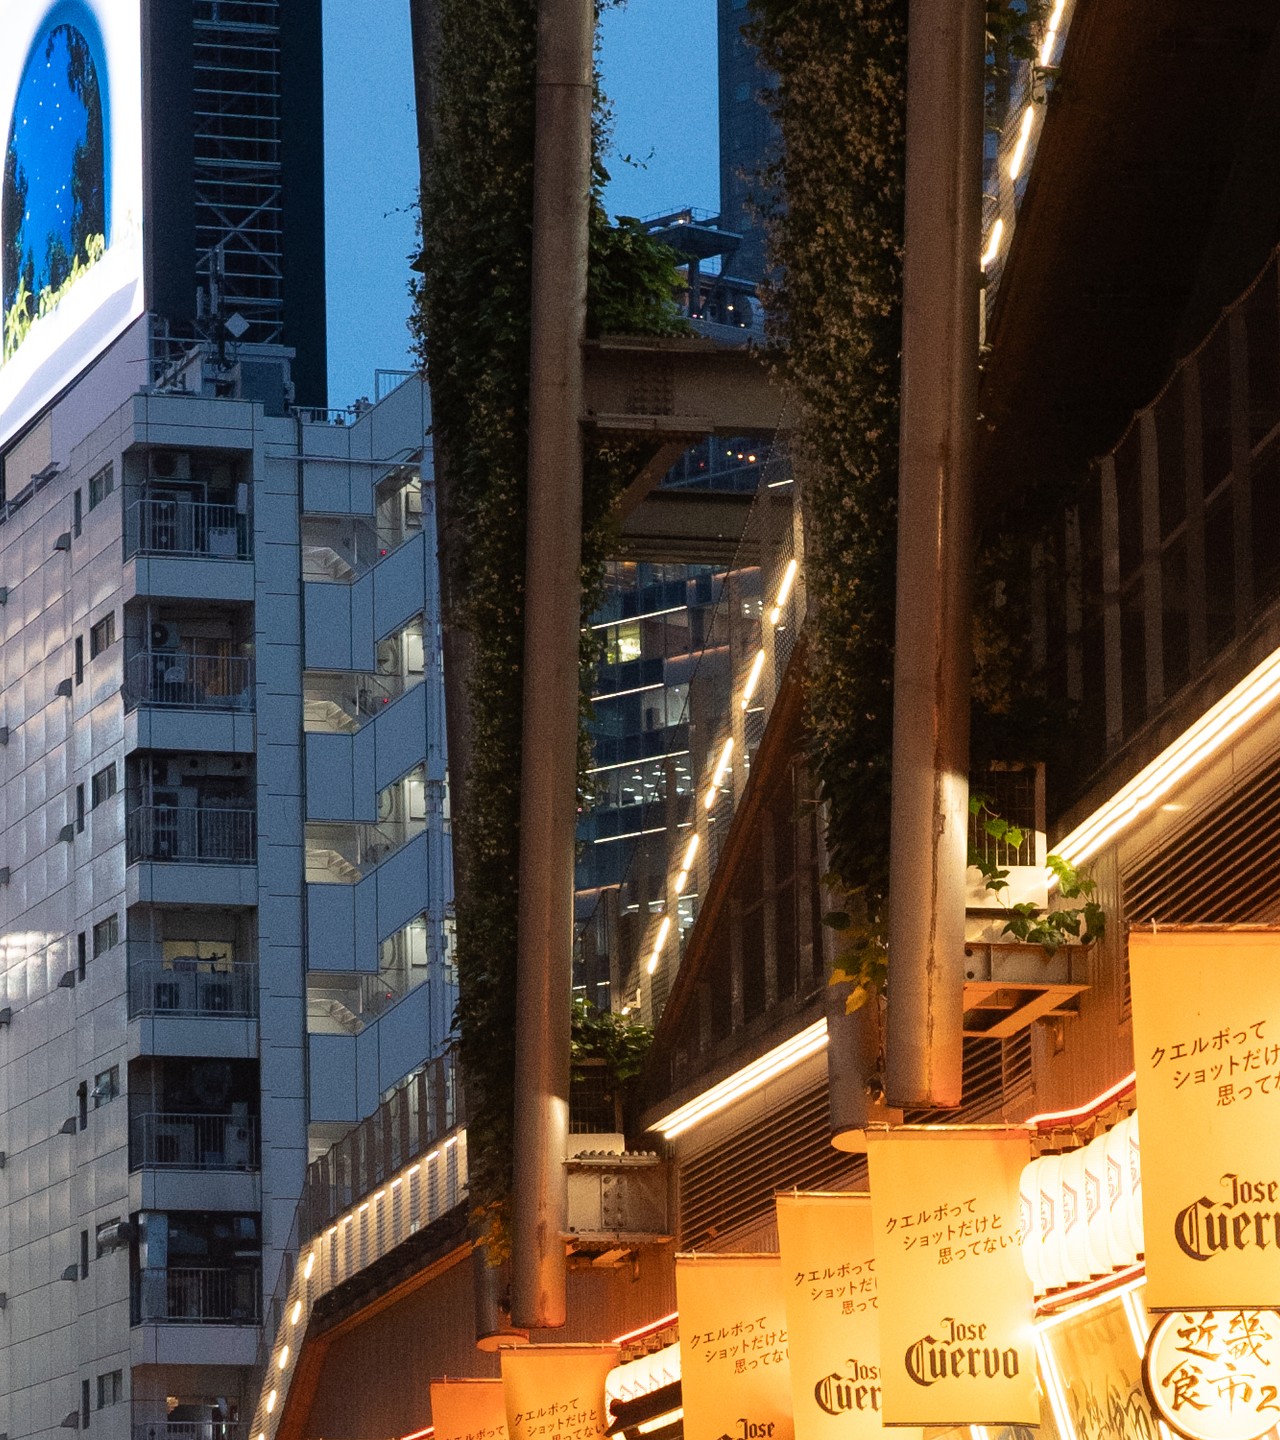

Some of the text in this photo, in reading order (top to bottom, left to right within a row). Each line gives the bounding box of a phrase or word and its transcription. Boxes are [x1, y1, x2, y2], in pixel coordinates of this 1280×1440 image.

[1151, 1020, 1266, 1068] クエルボって
[1220, 1173, 1279, 1210] Jose
[886, 1197, 977, 1234] クエルボって
[903, 1214, 1002, 1251] ショットだけと
[794, 1258, 876, 1286] クエルボって
[811, 1277, 878, 1301] ショットだ
[690, 1317, 767, 1349] クエルボって
[705, 1329, 788, 1363] ショットだけと
[940, 1317, 987, 1346] Jose
[1175, 1309, 1271, 1367] 近畿
[847, 1359, 881, 1382] Jos
[905, 1334, 1020, 1387] Cuervo
[514, 1397, 579, 1427] クエルボって
[526, 1410, 597, 1437] ショットだけと
